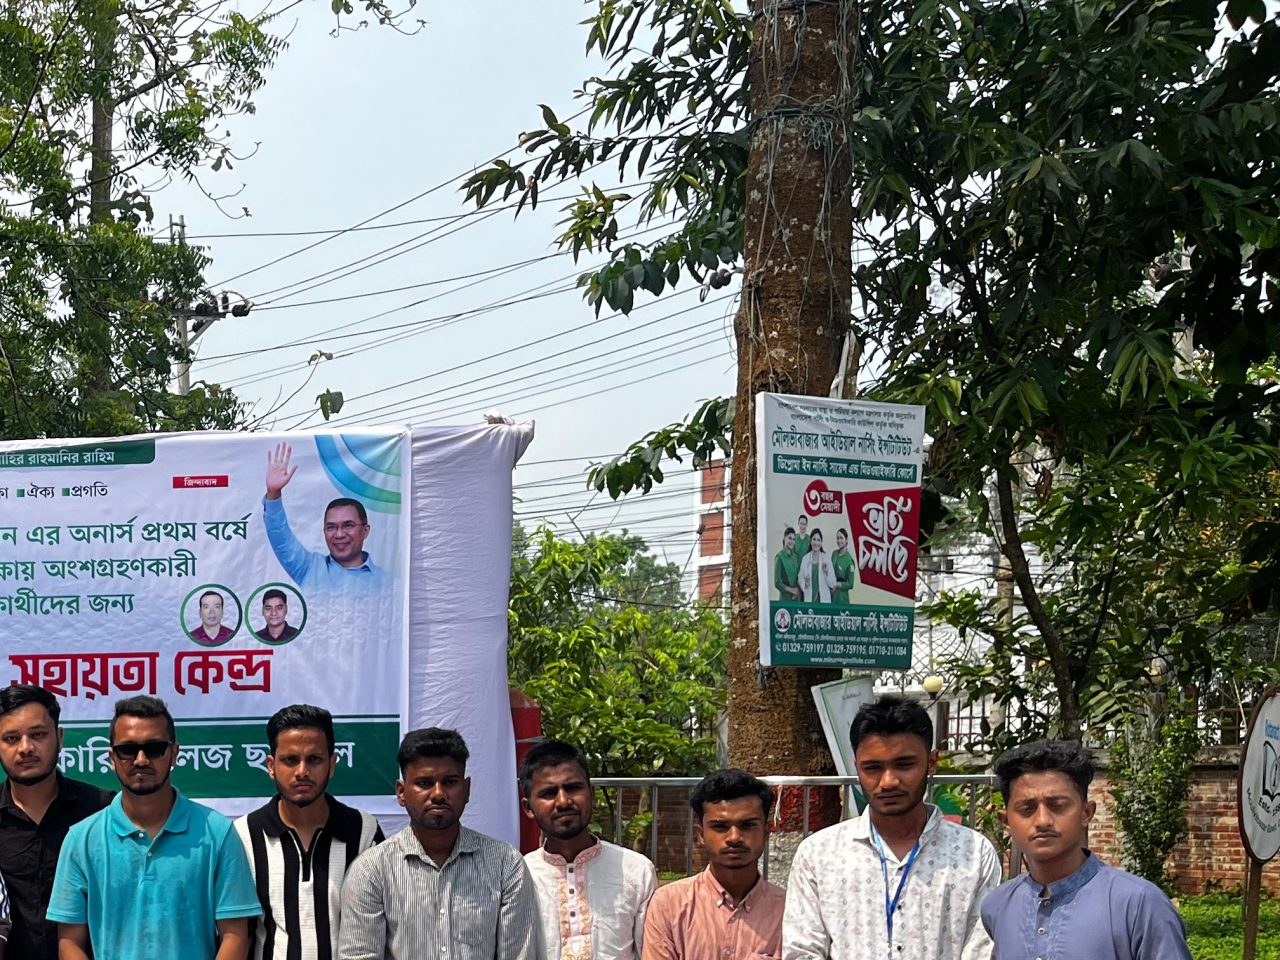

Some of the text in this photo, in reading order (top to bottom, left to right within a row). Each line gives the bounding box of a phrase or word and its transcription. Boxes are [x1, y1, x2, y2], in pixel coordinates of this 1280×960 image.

[772, 424, 819, 449] মৌলভীবাজার
[821, 428, 856, 452] আইডিয়াল
[858, 432, 876, 456] নার্সিং
[28, 449, 79, 466] রাহমানির
[83, 447, 115, 463] রাহিম
[777, 455, 800, 472] ডিপ্লোমা
[802, 456, 811, 472] ইন
[812, 458, 828, 474] নার্সিং
[27, 482, 55, 499] ঐক্য
[71, 481, 109, 498] প্রগতি
[805, 489, 820, 510] ৩
[821, 491, 834, 501] বছর
[26, 525, 61, 546] এর
[67, 515, 138, 544] অনার্স
[141, 521, 197, 543] প্রথম
[204, 512, 253, 541] বর্ষে
[862, 495, 912, 541] ভর্তি
[42, 548, 197, 580] অংশগ্রহণকারী
[858, 535, 916, 583] চলছে
[87, 593, 135, 614] জন্য
[793, 608, 832, 630] মৌলভীবাজার
[833, 610, 862, 631] আইডিয়াল
[863, 611, 878, 633] নার্সিং
[8, 651, 160, 701] সহায়তা
[173, 649, 274, 694] কেন্দ্র
